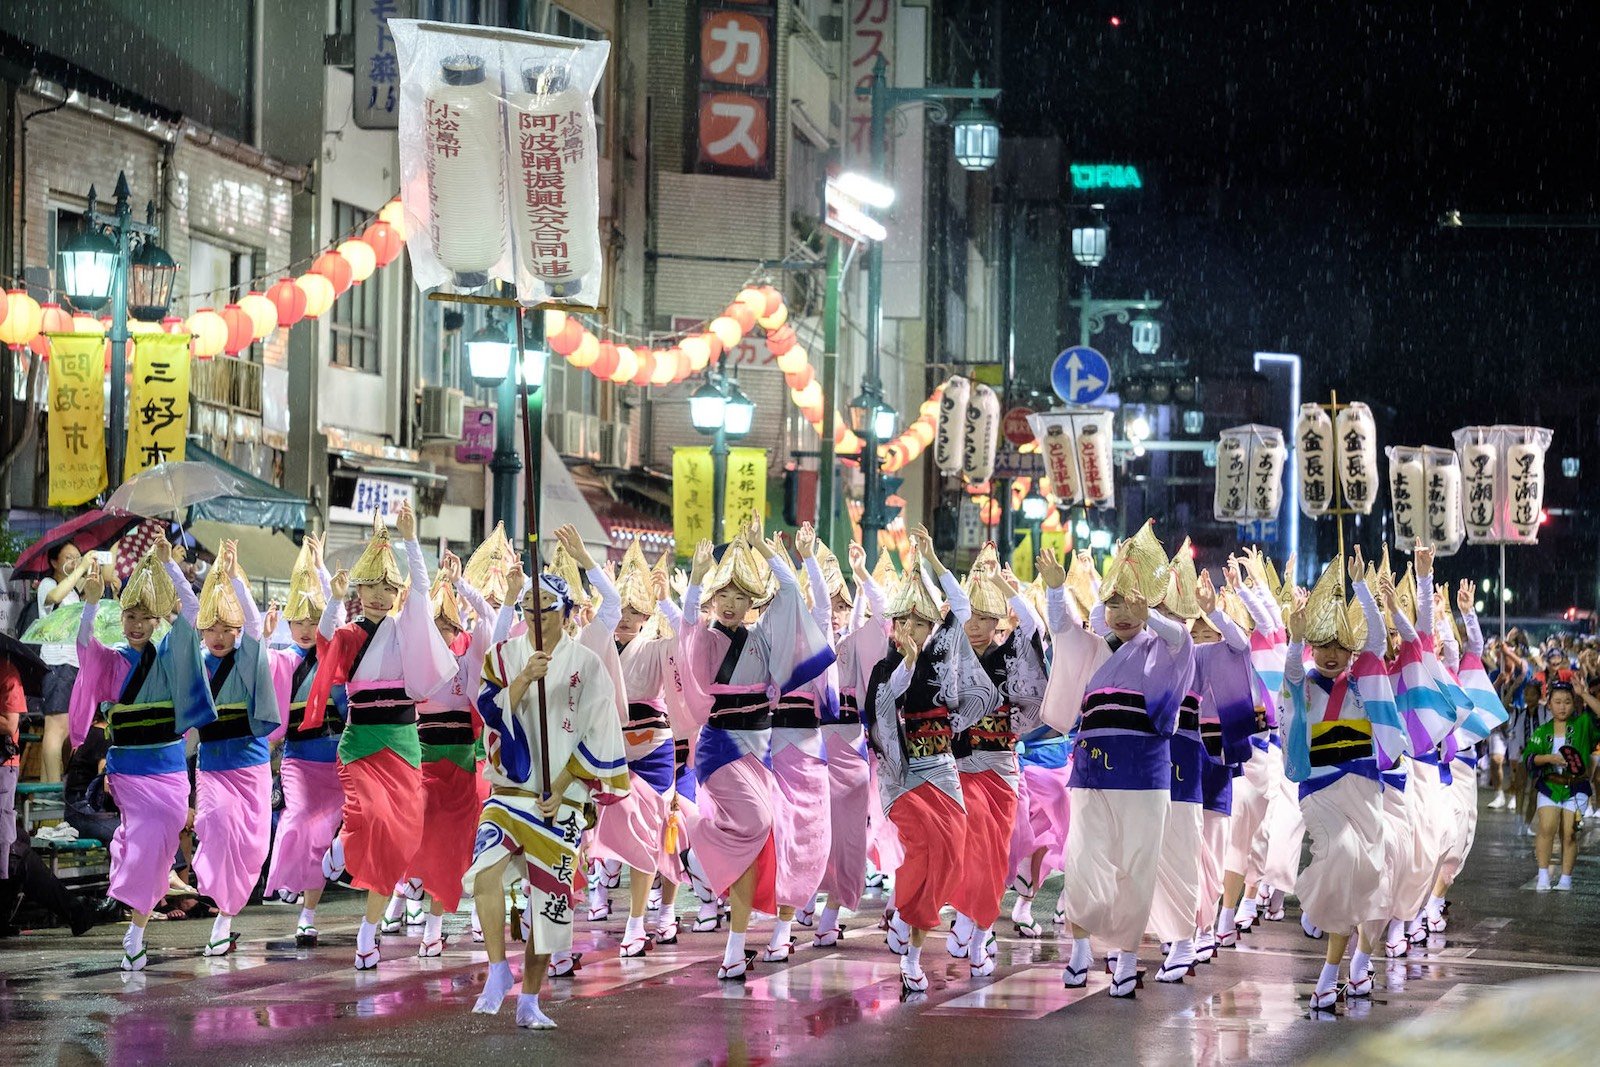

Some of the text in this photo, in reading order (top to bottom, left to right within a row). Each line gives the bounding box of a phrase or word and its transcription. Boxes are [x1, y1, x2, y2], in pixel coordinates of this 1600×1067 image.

[706, 19, 762, 159] カス
[435, 103, 461, 159] 小松島市
[558, 110, 585, 164] 小松島市
[140, 362, 183, 468] 三好市
[1224, 453, 1244, 510] あすか連
[1255, 453, 1273, 510] あすか連
[1302, 429, 1325, 500] 金長連
[1344, 429, 1367, 500] 金長連
[1466, 453, 1495, 527] 黒潮連
[1512, 453, 1540, 526] 黒潮連
[1393, 472, 1414, 538] よあかし連
[1429, 474, 1447, 541] よあかし連
[562, 671, 581, 733] 金長連
[540, 811, 581, 925] 金長連
